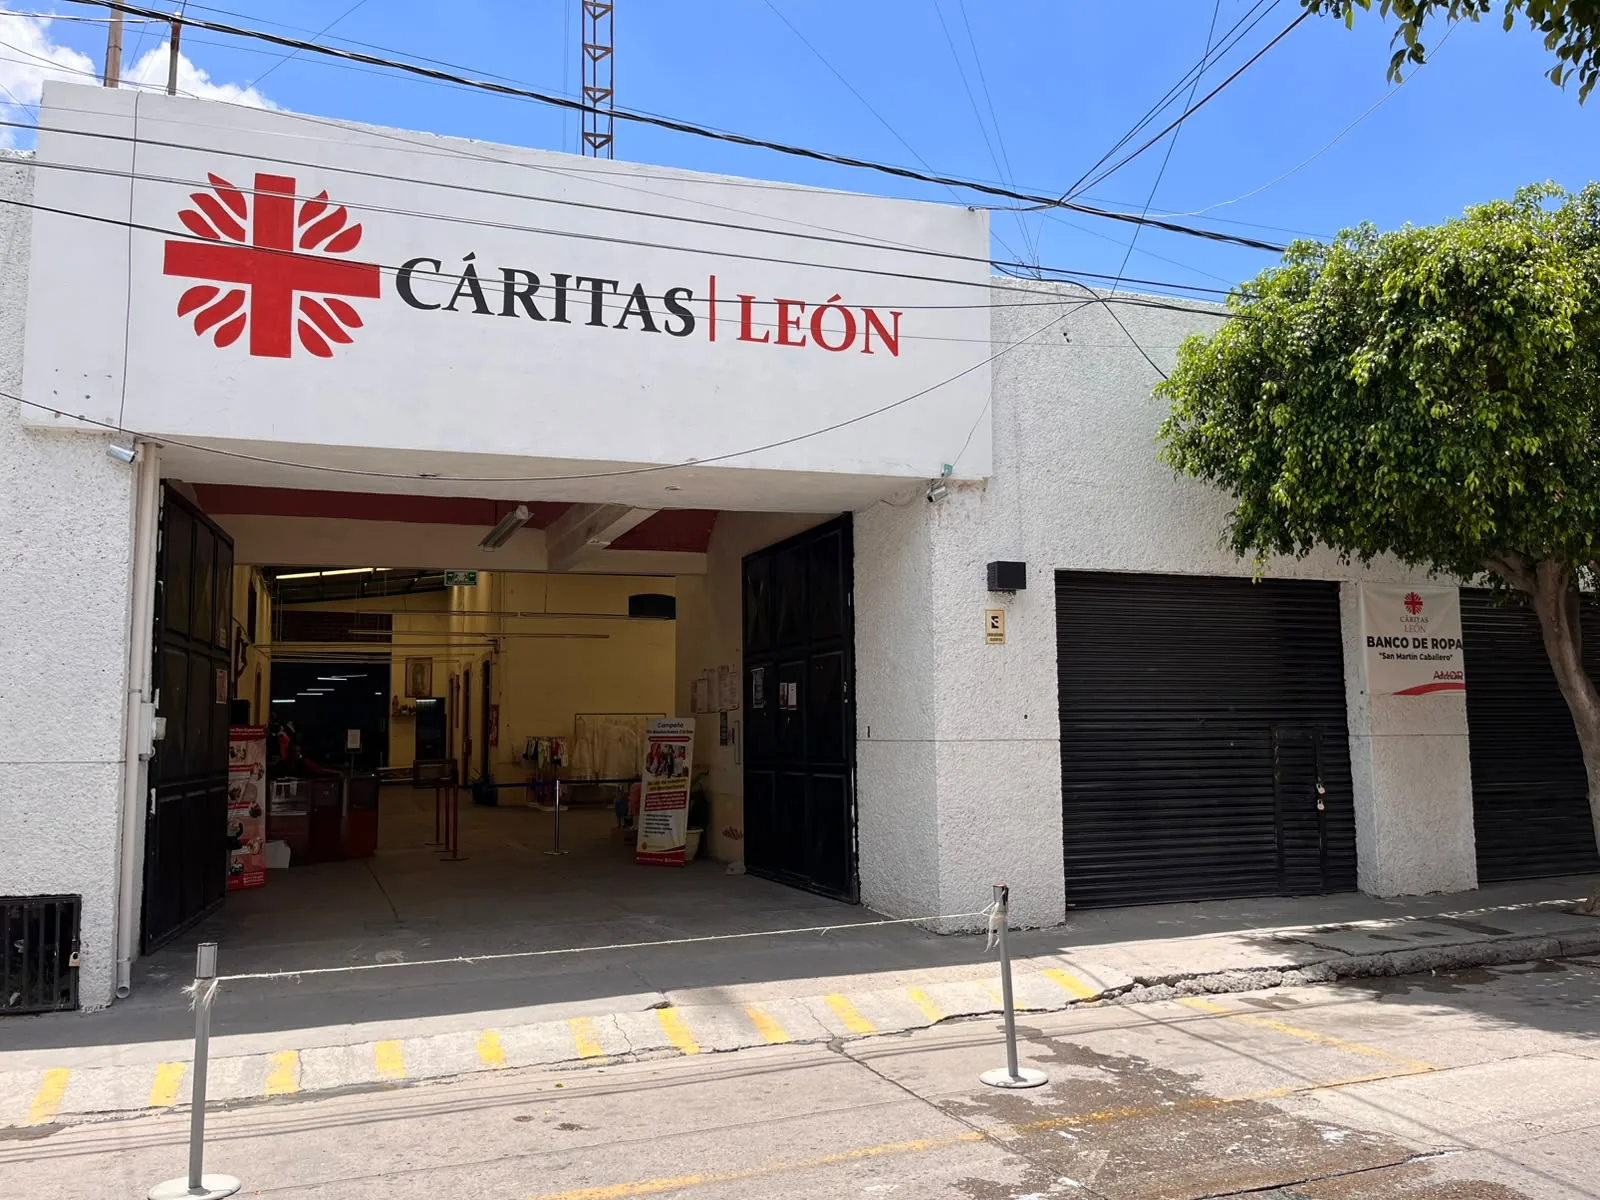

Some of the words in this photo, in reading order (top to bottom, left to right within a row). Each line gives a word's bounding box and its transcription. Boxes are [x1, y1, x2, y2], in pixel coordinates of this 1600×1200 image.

[395, 251, 696, 338] CÁRITAS
[736, 293, 903, 357] LEÓN
[1400, 615, 1429, 623] CÁRITAS
[1404, 623, 1426, 633] LEÓN
[1367, 636, 1410, 649] BANCO
[1412, 637, 1429, 649] DE
[1431, 638, 1464, 651] ROPA
